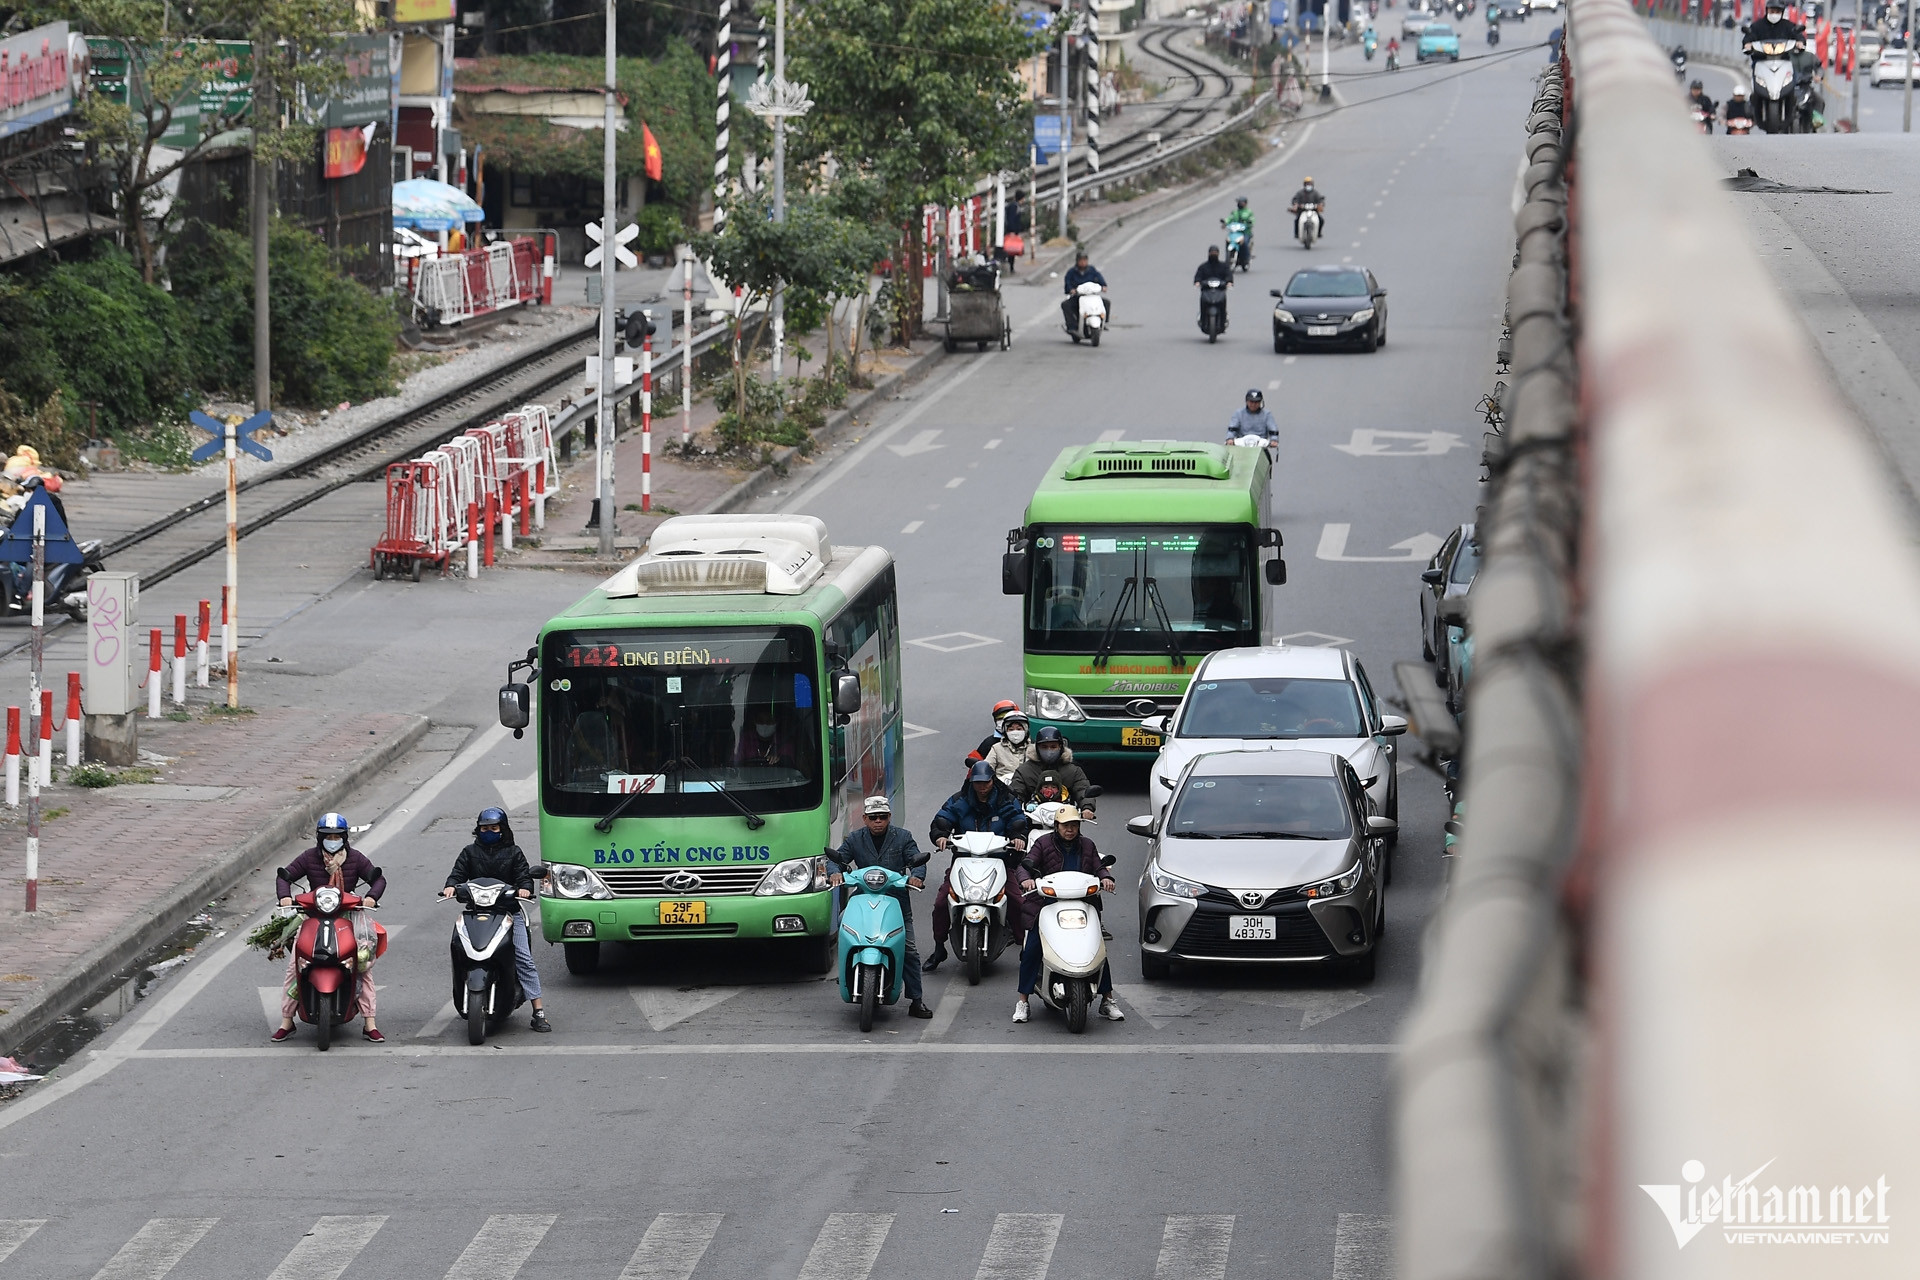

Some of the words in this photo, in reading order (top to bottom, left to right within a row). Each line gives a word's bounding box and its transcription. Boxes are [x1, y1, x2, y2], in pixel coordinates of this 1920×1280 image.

[567, 645, 619, 667] 142
[620, 652, 659, 667] ONG
[1126, 737, 1157, 746] 189.09
[593, 842, 635, 864] BẢO
[640, 840, 680, 863] YẾN
[685, 846, 726, 861] CNG
[732, 845, 770, 861] BUS
[672, 902, 692, 913] 29F
[664, 913, 700, 923] 034.71
[1243, 918, 1263, 928] 30H
[1235, 928, 1271, 939] 483.75
